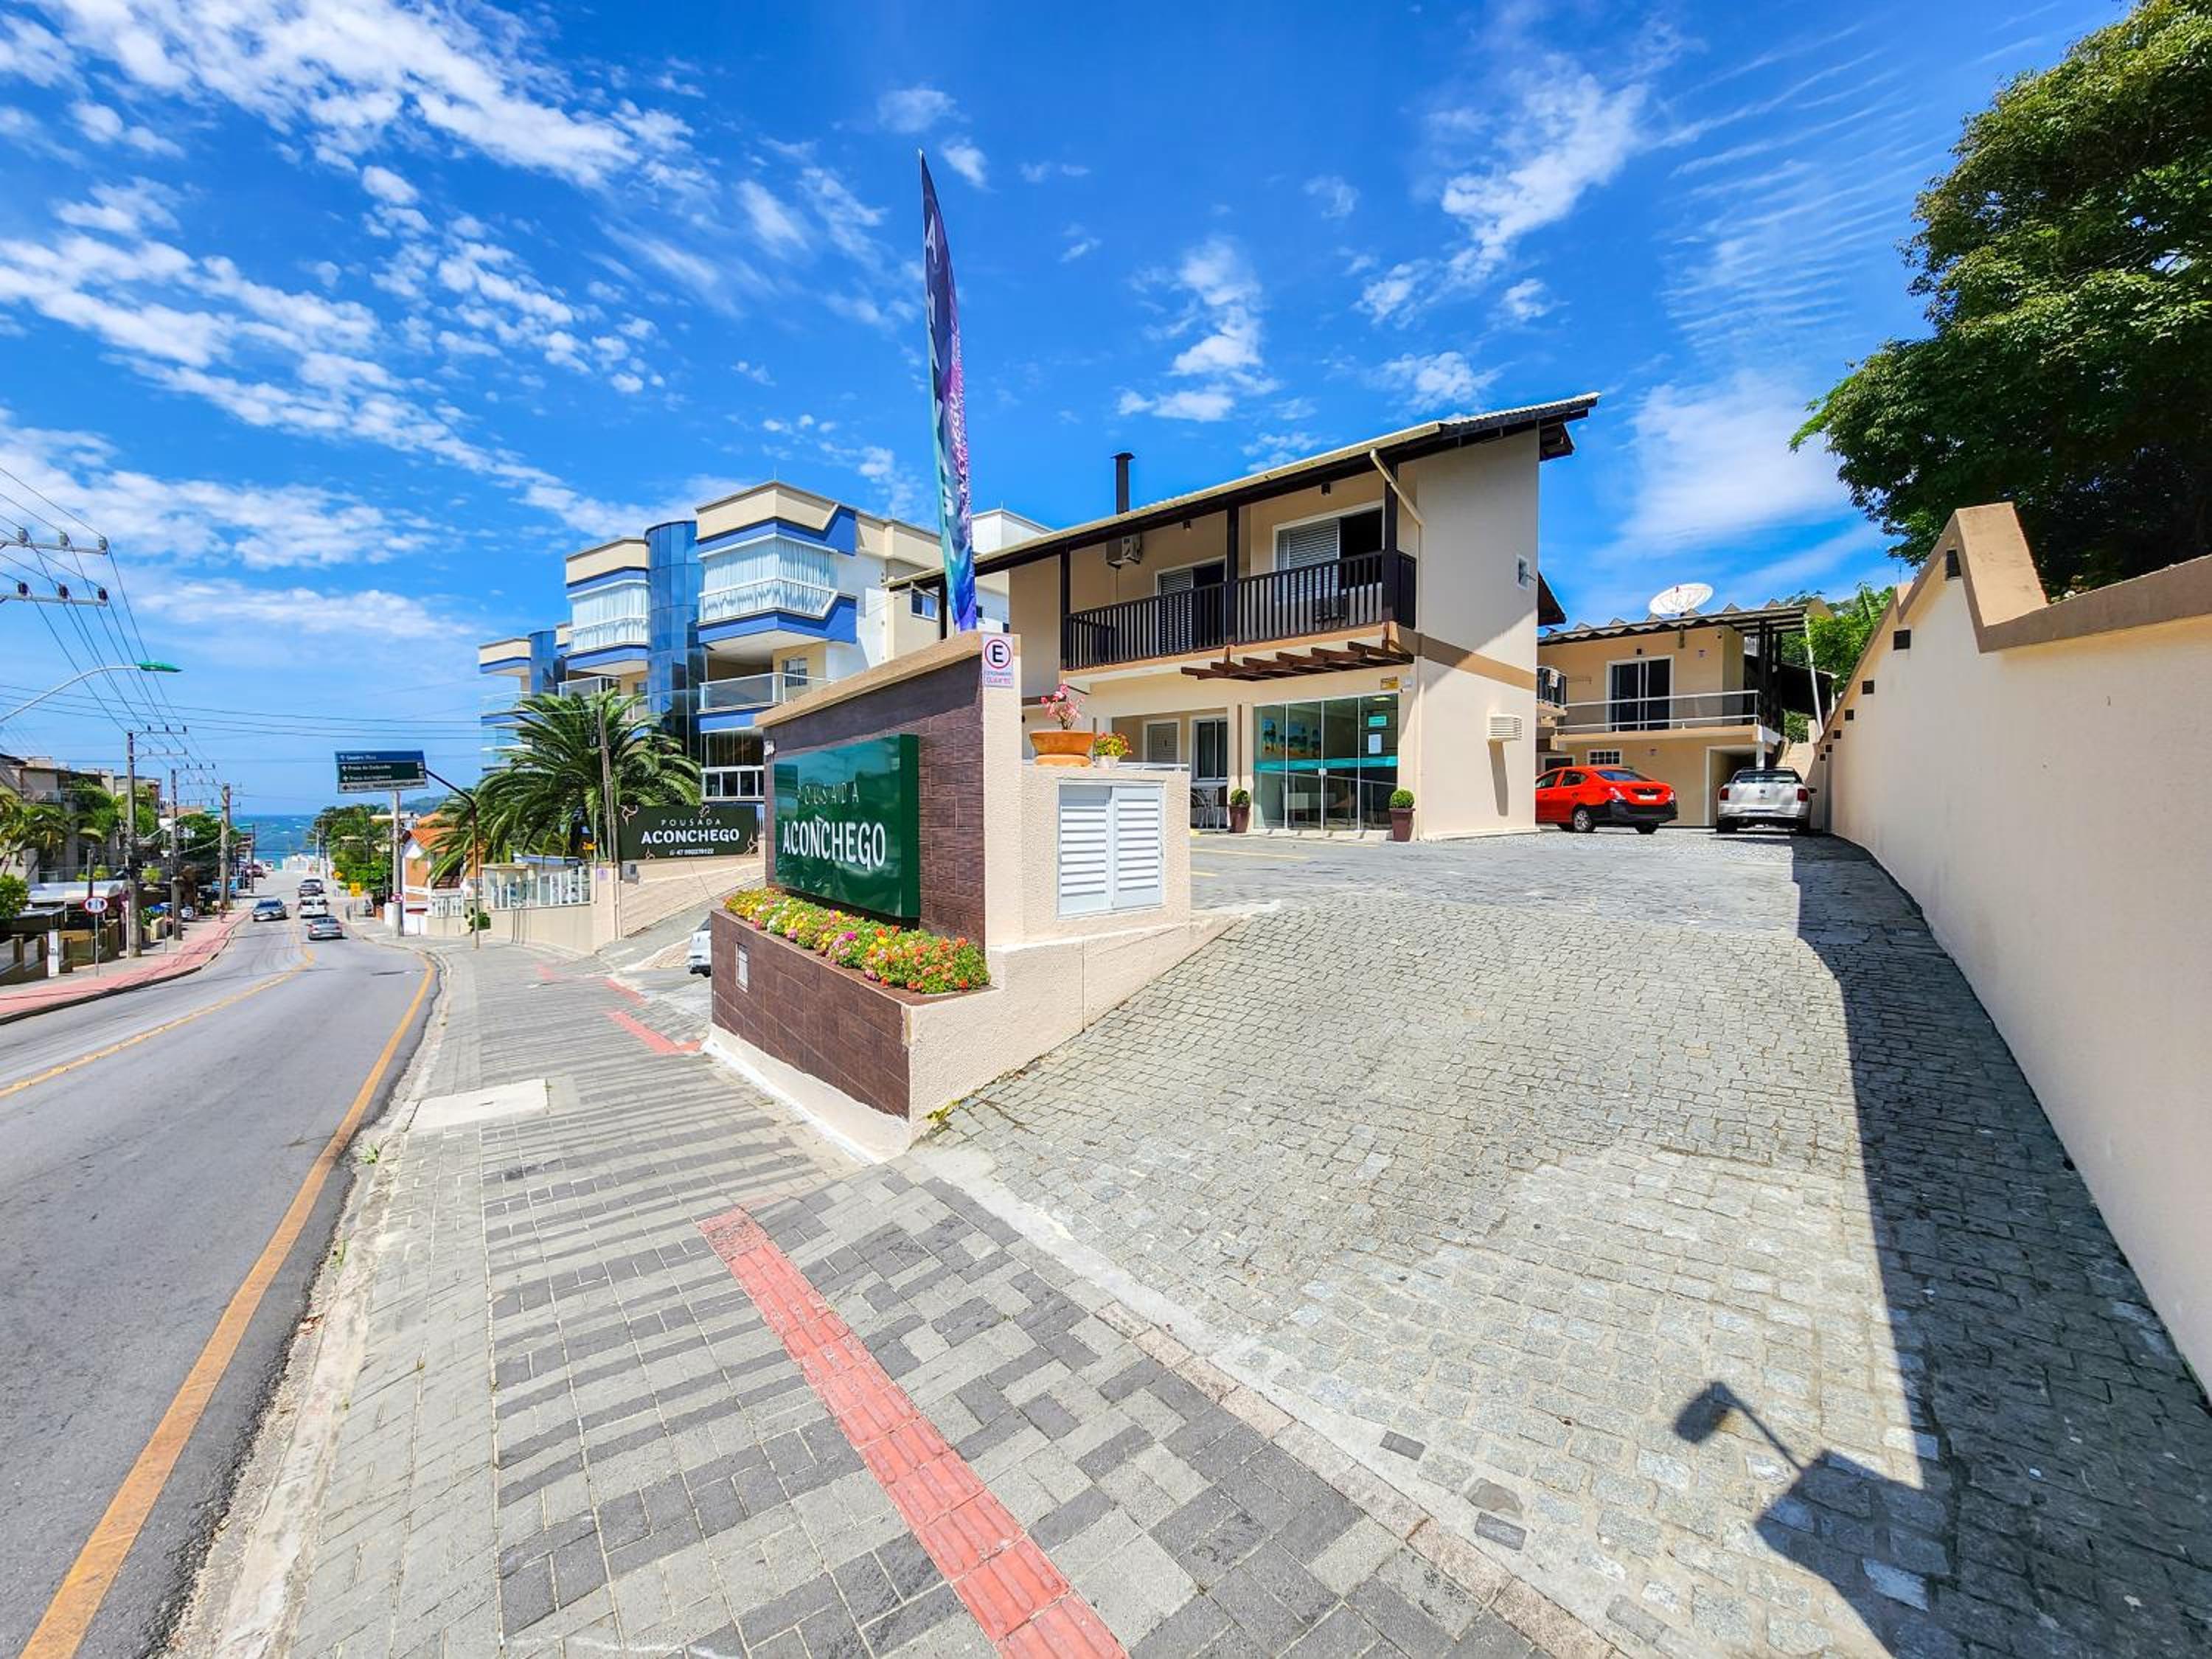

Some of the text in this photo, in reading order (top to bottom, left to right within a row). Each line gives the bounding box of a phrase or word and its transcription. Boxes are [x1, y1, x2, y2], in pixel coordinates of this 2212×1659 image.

[992, 644, 1004, 662] E
[661, 818, 721, 826] POUSADA
[641, 828, 740, 844] ACONCHEGO
[782, 820, 886, 870] ACONCHEGO
